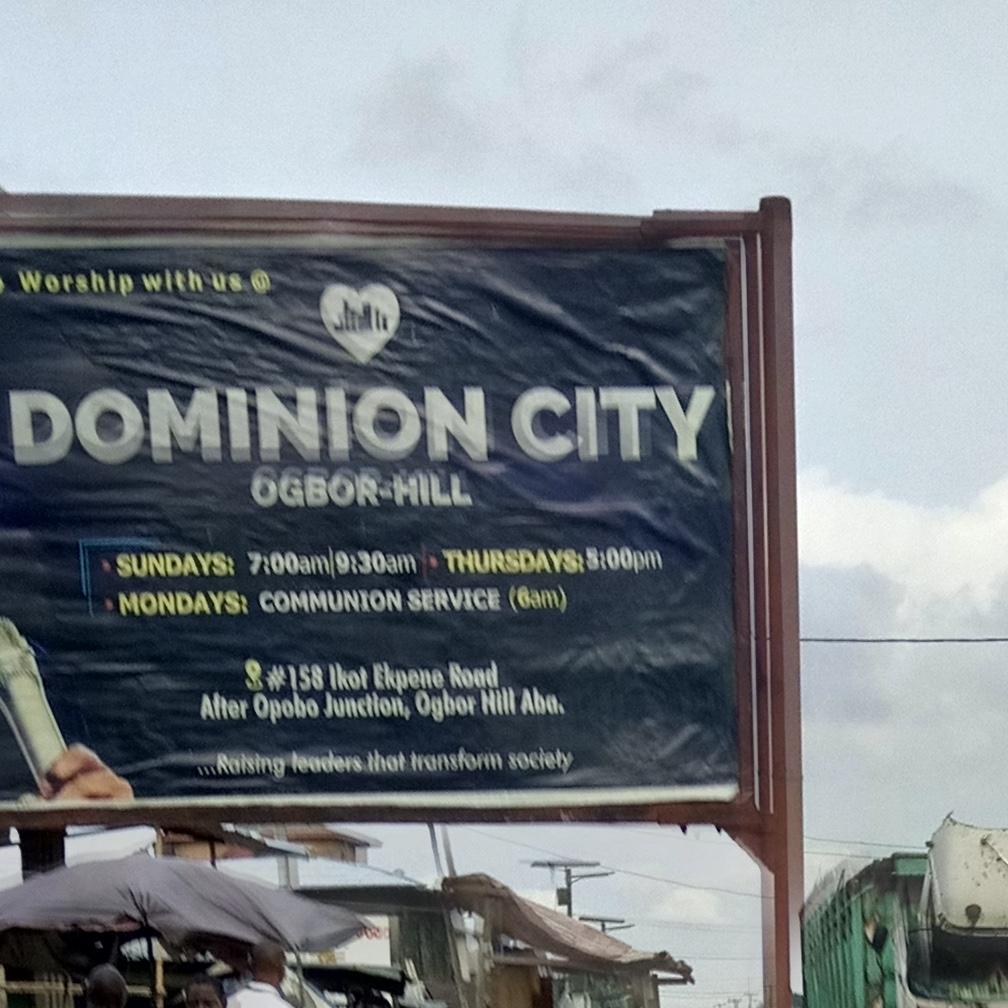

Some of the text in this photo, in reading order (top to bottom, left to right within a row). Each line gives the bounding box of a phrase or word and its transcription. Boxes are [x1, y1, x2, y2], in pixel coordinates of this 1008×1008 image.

[18, 269, 135, 296] Worship
[142, 269, 204, 293] with
[211, 271, 243, 293] us
[8, 385, 716, 466] DOMINION CITY
[250, 468, 473, 508] OGBOR-HILL
[116, 551, 235, 578] SUNDAYS:
[441, 548, 584, 574] THURSDAYS:
[117, 584, 568, 617] MONDAYS: COMMUNION SERVICE (6am)
[328, 661, 368, 691] Ikot
[372, 661, 444, 696] Ekpene
[448, 660, 499, 689] Road
[200, 692, 248, 721] After
[253, 692, 320, 724] Opobo
[323, 691, 410, 721] Junction,
[414, 687, 477, 722] Ogbor
[480, 685, 517, 716] Hill
[291, 750, 364, 775] leaders
[367, 749, 406, 774] that
[410, 747, 503, 773] transform
[508, 747, 574, 775] society
